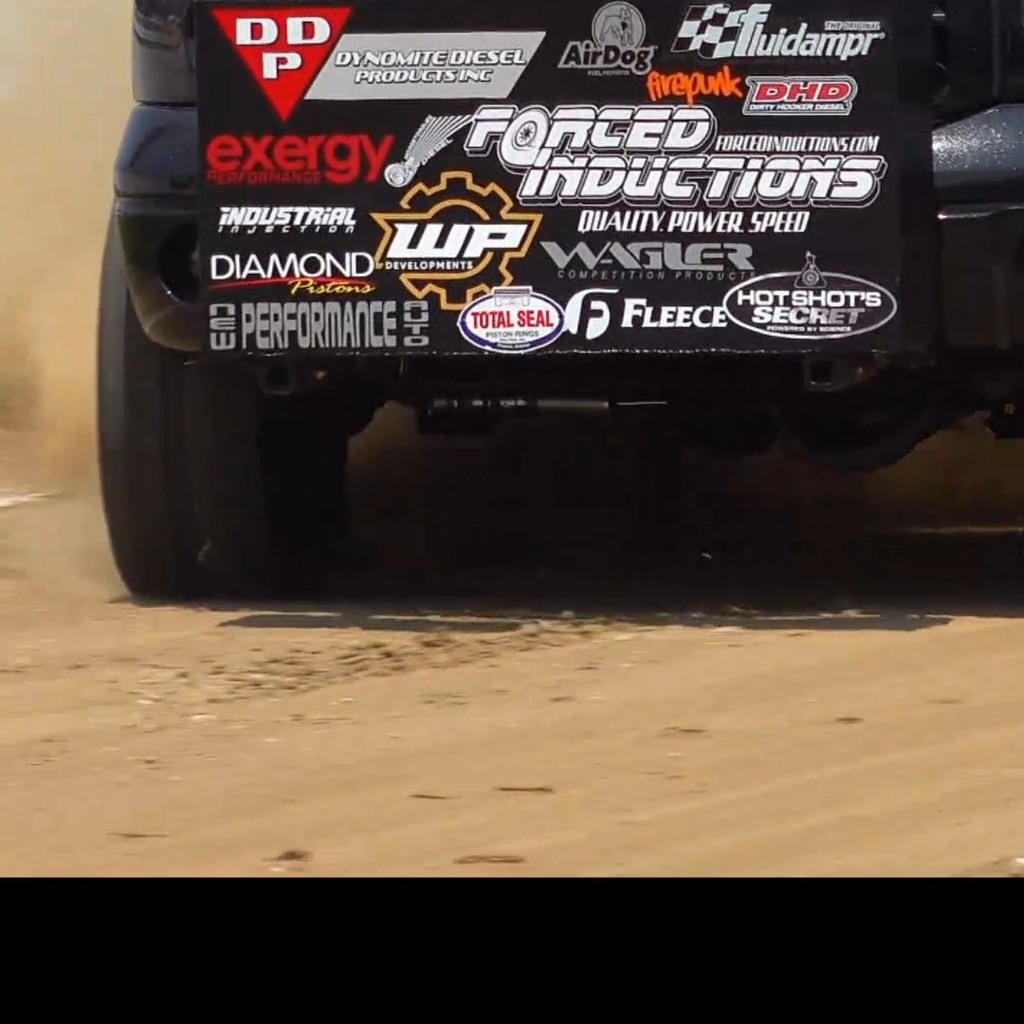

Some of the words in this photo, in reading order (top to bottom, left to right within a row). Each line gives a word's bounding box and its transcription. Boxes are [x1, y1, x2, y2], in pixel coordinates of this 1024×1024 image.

[335, 50, 448, 67] DYNOMITE
[450, 49, 528, 66] DIESEL
[558, 40, 655, 75] AirDog
[355, 69, 456, 84] PRODUCTS
[458, 69, 494, 83] INC
[646, 65, 744, 107] firepunk
[753, 81, 853, 103] DHD
[464, 105, 718, 170] FORCED
[715, 134, 880, 153] FORCEDINDUCTIONS.COM
[206, 133, 395, 184] exergy
[516, 151, 888, 208] INDUCTIONS
[749, 211, 811, 233] SPEED
[210, 252, 375, 280] DIAMOND
[385, 261, 474, 271] DEVELOPMENTS
[539, 241, 756, 271] WAGLER
[556, 269, 666, 280] COMPETITION
[287, 277, 377, 295] Pistons
[241, 300, 397, 350] PERFORMANCE
[471, 311, 514, 330] TOTAL
[517, 309, 554, 328] SEAL
[751, 306, 866, 324] SECRET
[485, 331, 513, 339] PISTON
